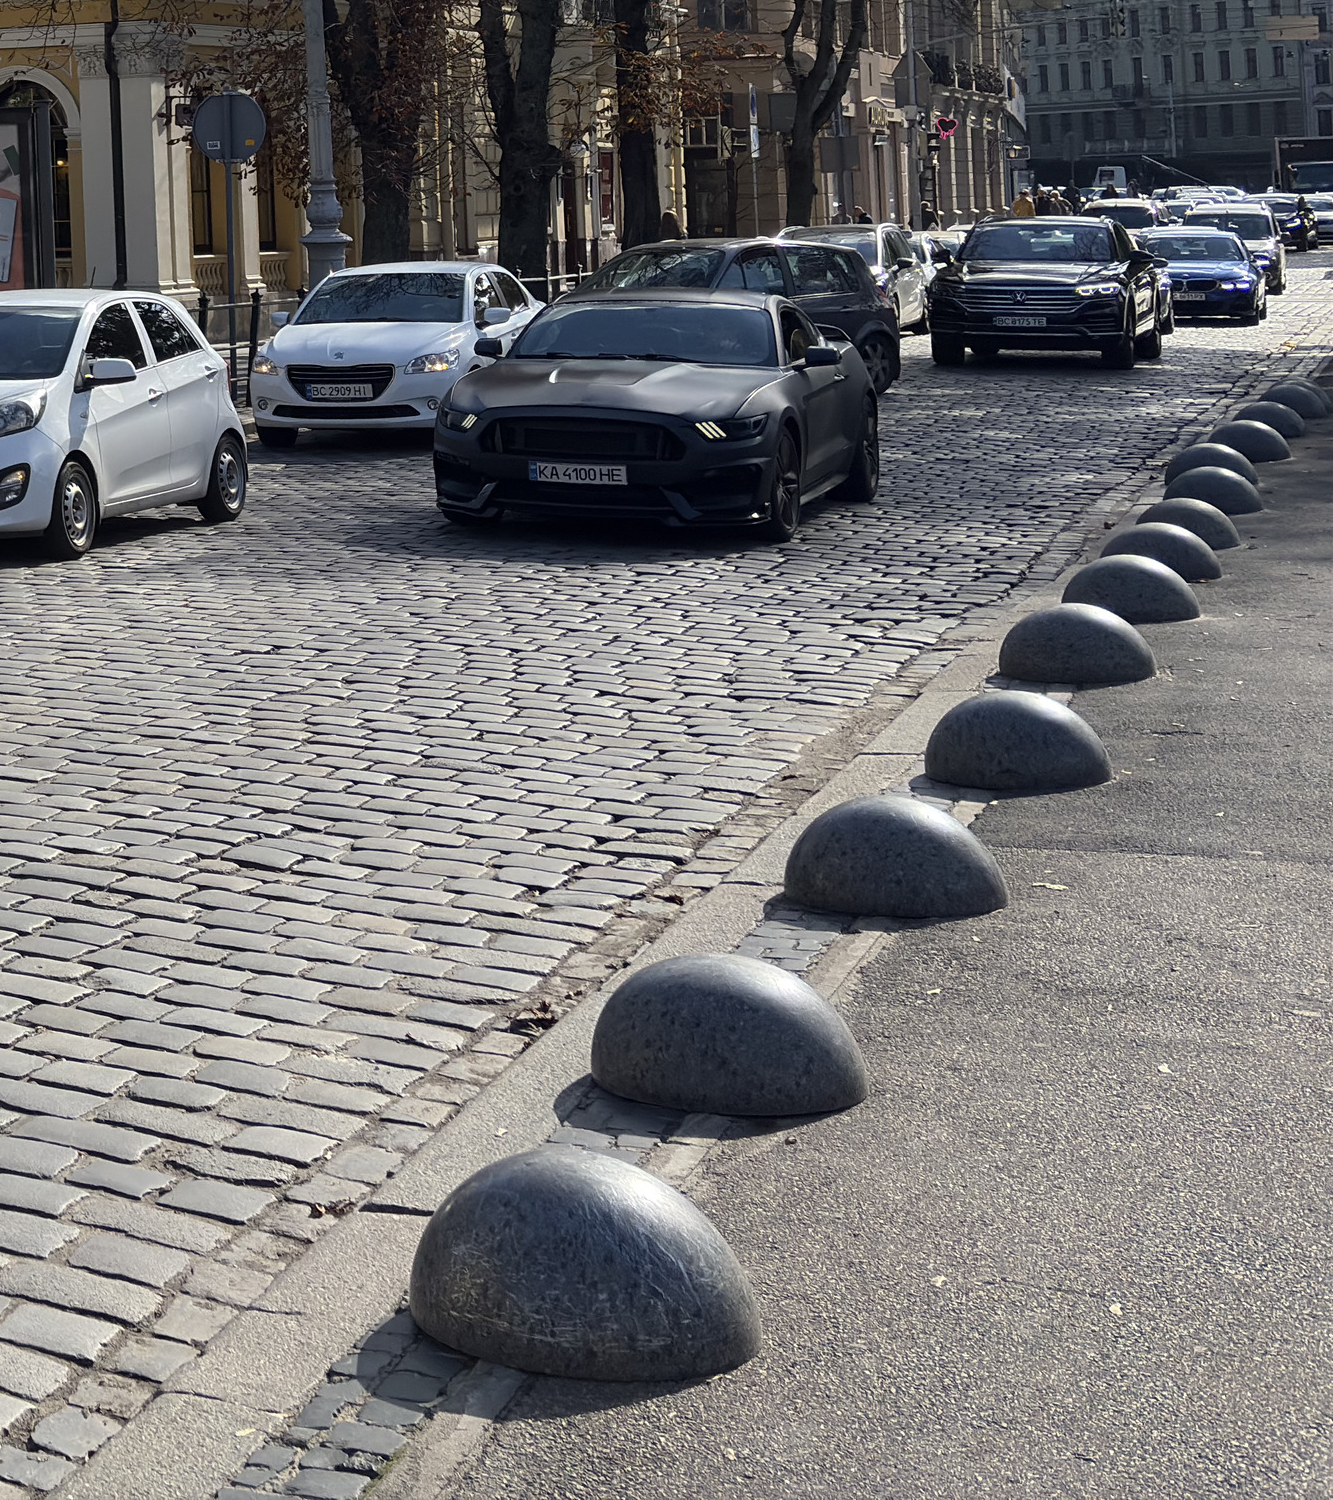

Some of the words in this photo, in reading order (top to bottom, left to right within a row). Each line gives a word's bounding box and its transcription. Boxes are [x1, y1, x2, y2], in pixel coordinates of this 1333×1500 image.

[313, 386, 327, 396] BC
[328, 386, 352, 397] 2909
[538, 465, 560, 480] KA
[562, 467, 597, 481] 4100
[599, 468, 623, 482] HE
